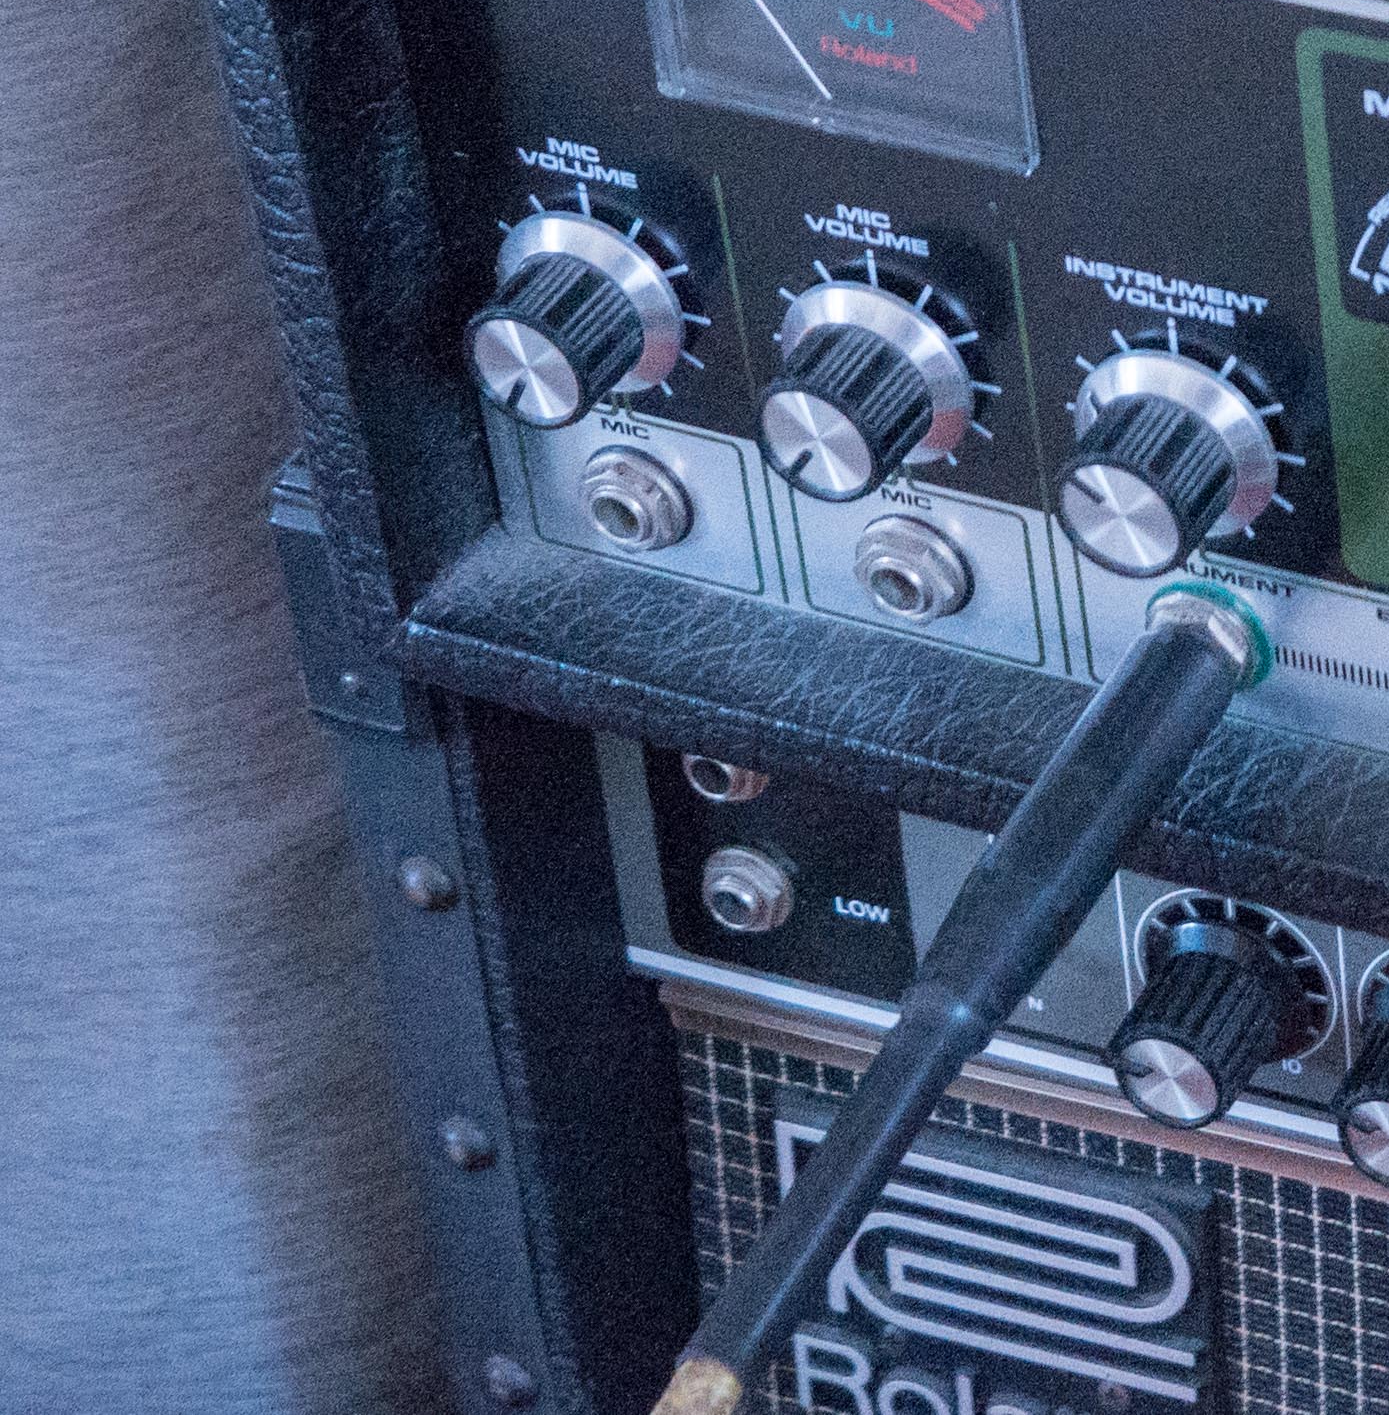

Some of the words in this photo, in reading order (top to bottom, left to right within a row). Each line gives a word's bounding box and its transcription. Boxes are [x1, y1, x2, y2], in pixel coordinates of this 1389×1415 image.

[837, 9, 895, 38] VU
[546, 136, 600, 164] MIC
[516, 146, 638, 190] VOLUME
[835, 204, 891, 231] MIC
[803, 213, 930, 258] VOLUME
[1063, 254, 1268, 316] INSTRUMENT
[1102, 281, 1235, 327] VOLUME
[600, 414, 650, 442] MIC
[880, 484, 933, 512] MIC
[833, 894, 891, 924] LOW
